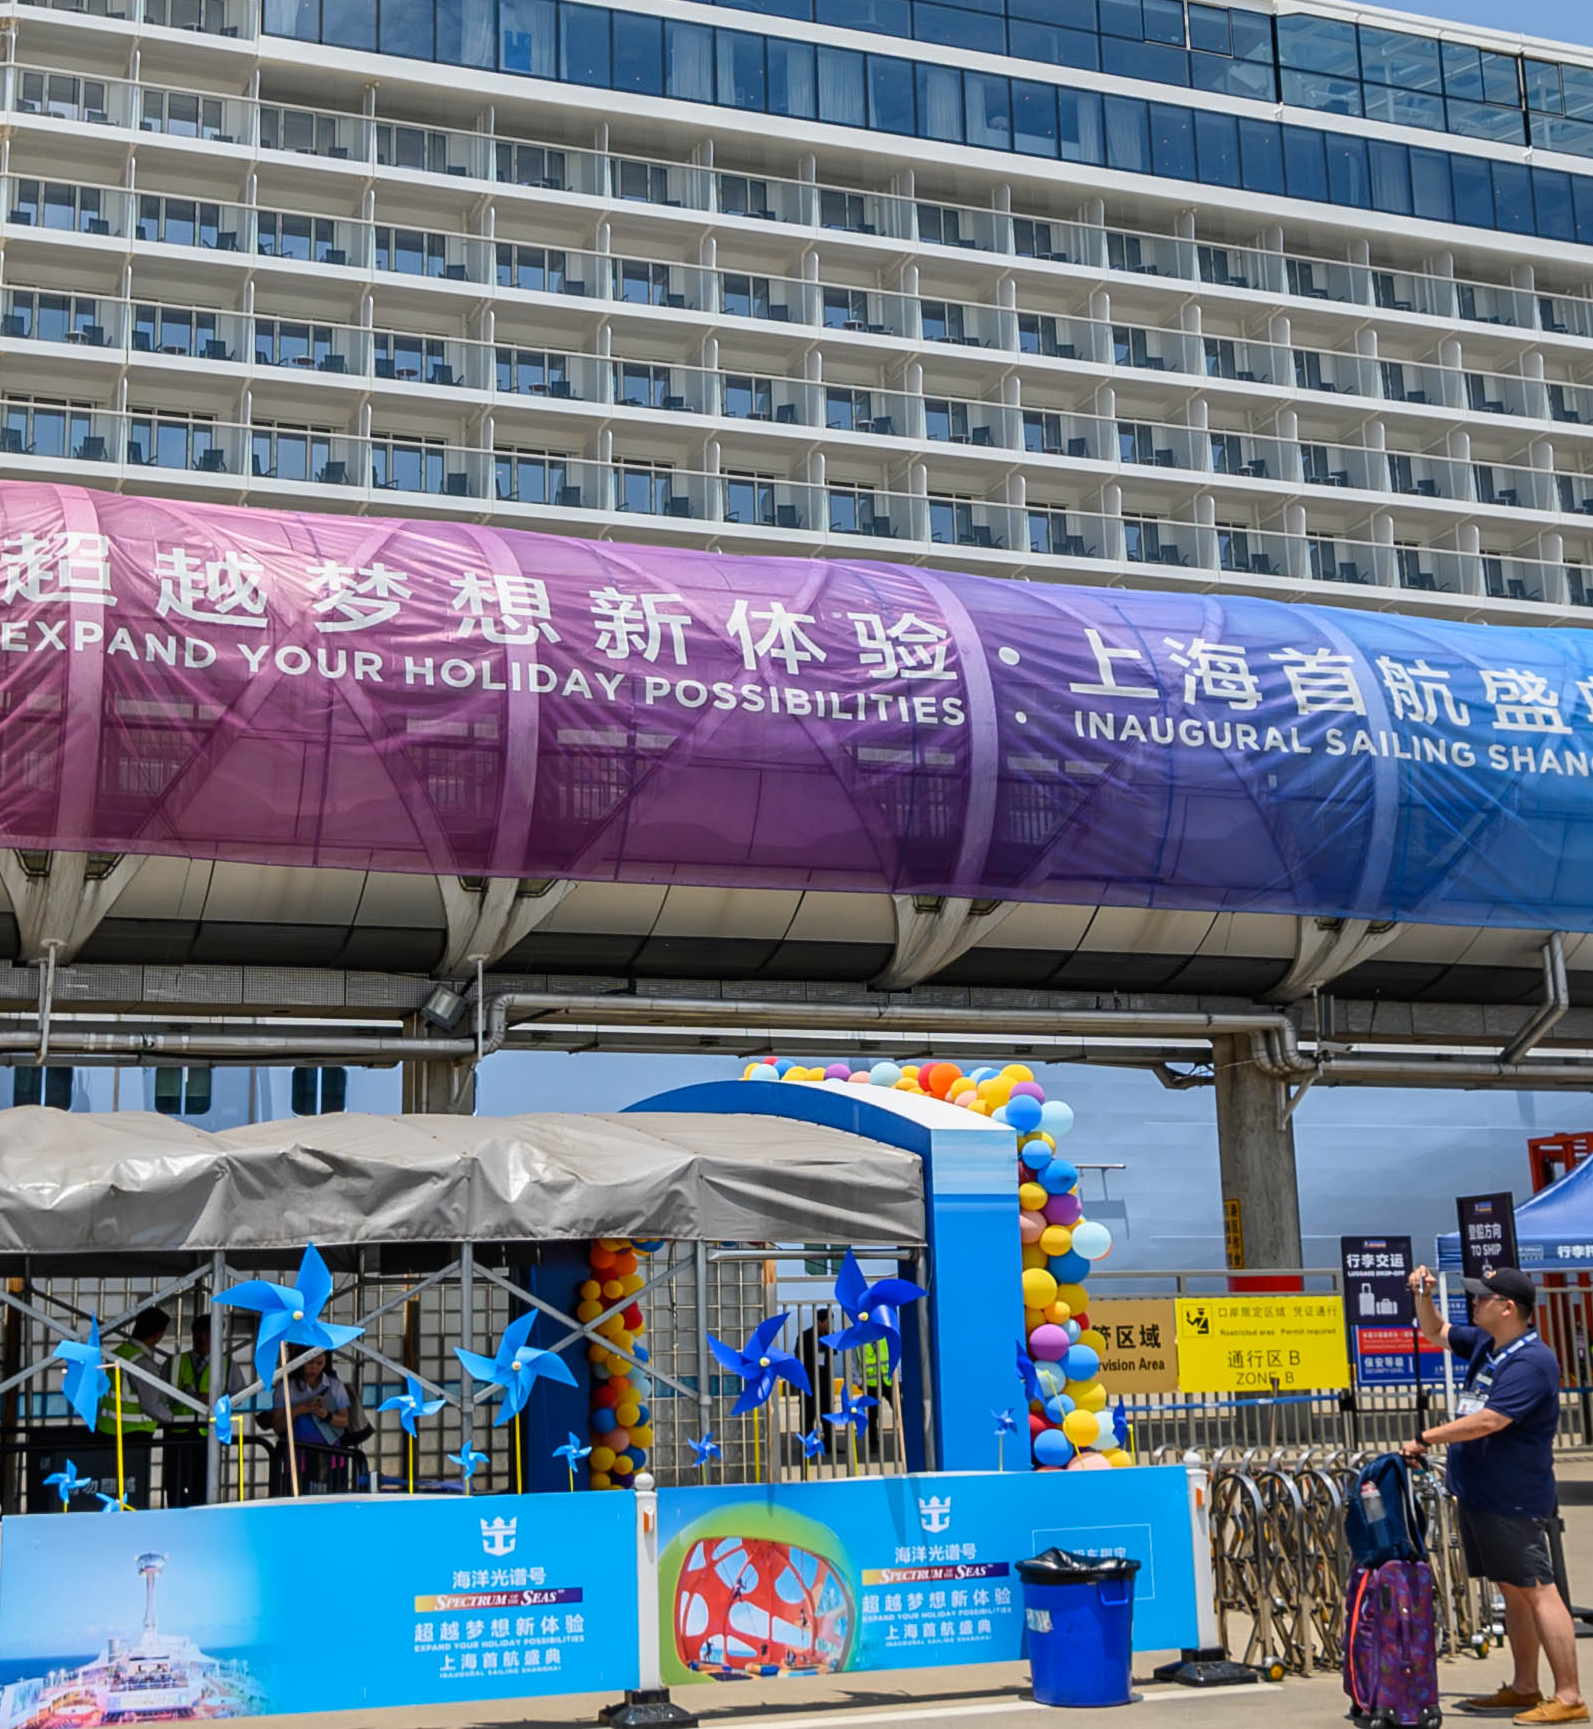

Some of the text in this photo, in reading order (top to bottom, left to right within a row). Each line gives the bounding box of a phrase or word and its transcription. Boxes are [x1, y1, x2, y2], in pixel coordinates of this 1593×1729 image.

[0, 531, 958, 681] 超越梦想新体验
[1, 620, 966, 727] EXPAND YOUR HOLIDAY POSSIBILITIES
[1074, 710, 1311, 755] INAUGURAL
[1325, 728, 1477, 768] SAILING
[1470, 1242, 1502, 1257] TO SHIP
[1139, 1357, 1165, 1370] Area
[1227, 1350, 1301, 1368] 通行区 B
[879, 1568, 943, 1584] SPECTRUM
[955, 1564, 987, 1580] SEAS
[434, 1594, 506, 1611] SPECTRUM
[521, 1589, 557, 1606] SEAS
